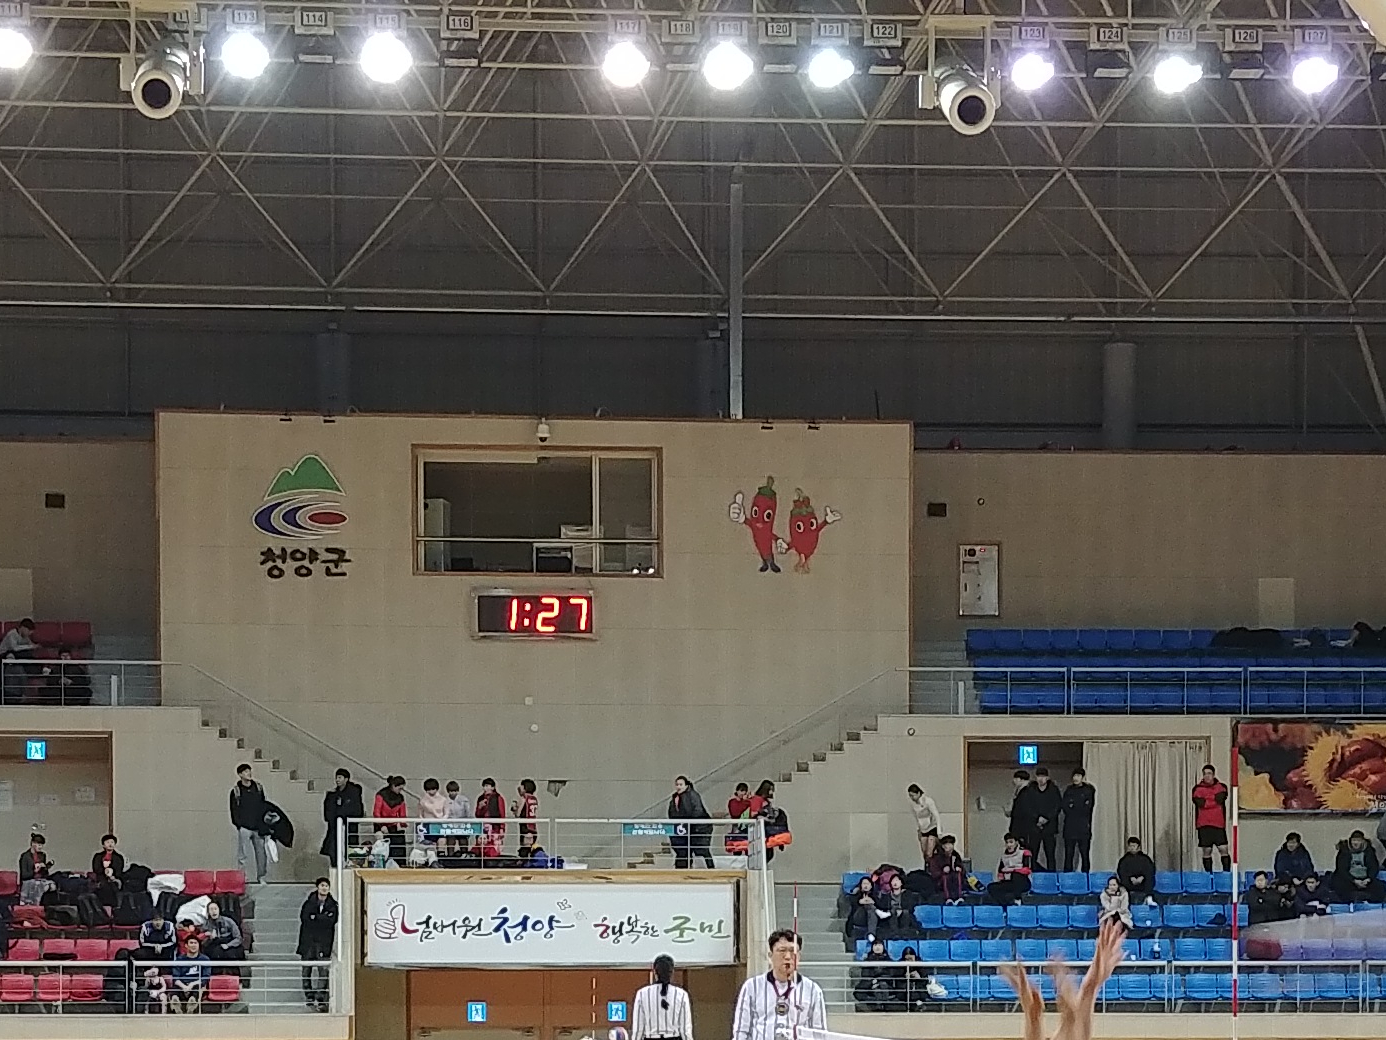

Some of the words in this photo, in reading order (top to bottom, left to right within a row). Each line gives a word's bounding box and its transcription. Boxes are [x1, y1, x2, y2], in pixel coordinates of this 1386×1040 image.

[259, 547, 352, 579] 청양군
[509, 597, 590, 633] 1:27
[663, 914, 731, 943] 군민
